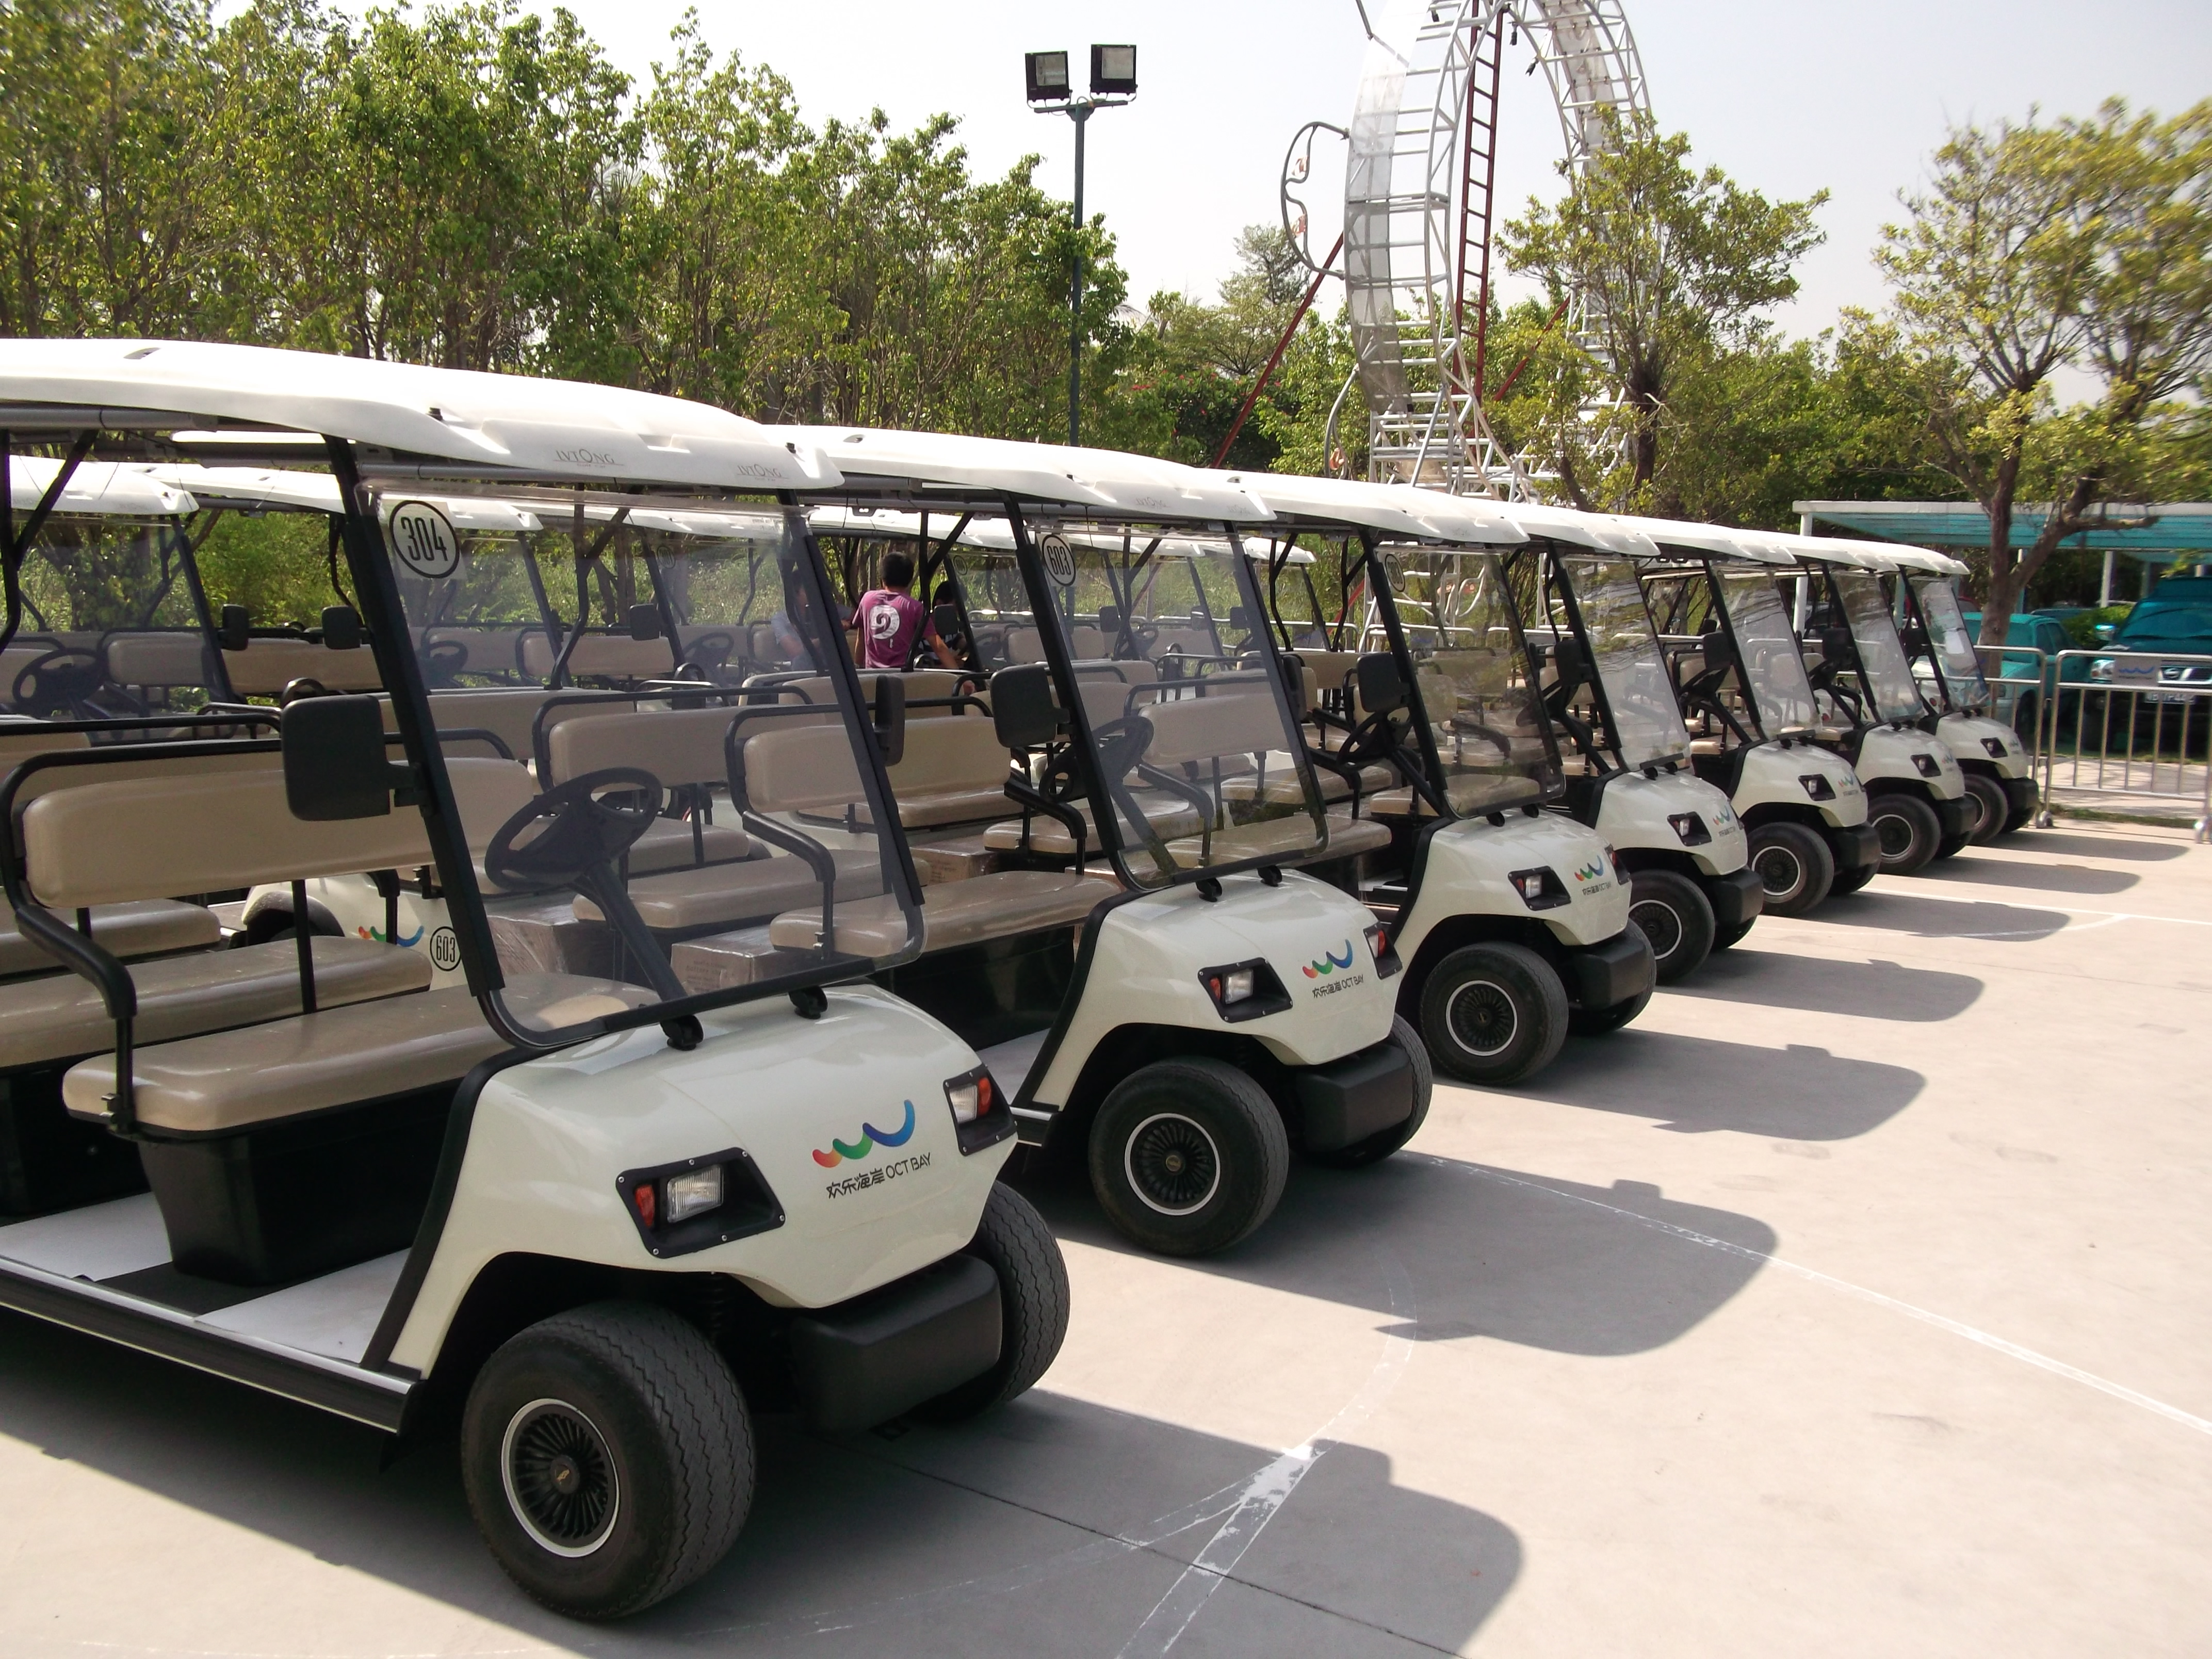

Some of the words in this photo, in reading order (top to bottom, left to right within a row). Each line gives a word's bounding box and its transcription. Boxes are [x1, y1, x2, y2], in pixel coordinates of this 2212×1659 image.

[400, 517, 448, 561] 304
[1046, 545, 1071, 575] 603
[436, 935, 456, 963] 603
[1312, 981, 1342, 998] 欢乐海岸
[1341, 977, 1354, 989] OCT
[1353, 973, 1363, 985] BAY
[826, 1167, 885, 1199] 欢乐海岸
[885, 1159, 908, 1179] OCT
[910, 1151, 931, 1170] BAY
